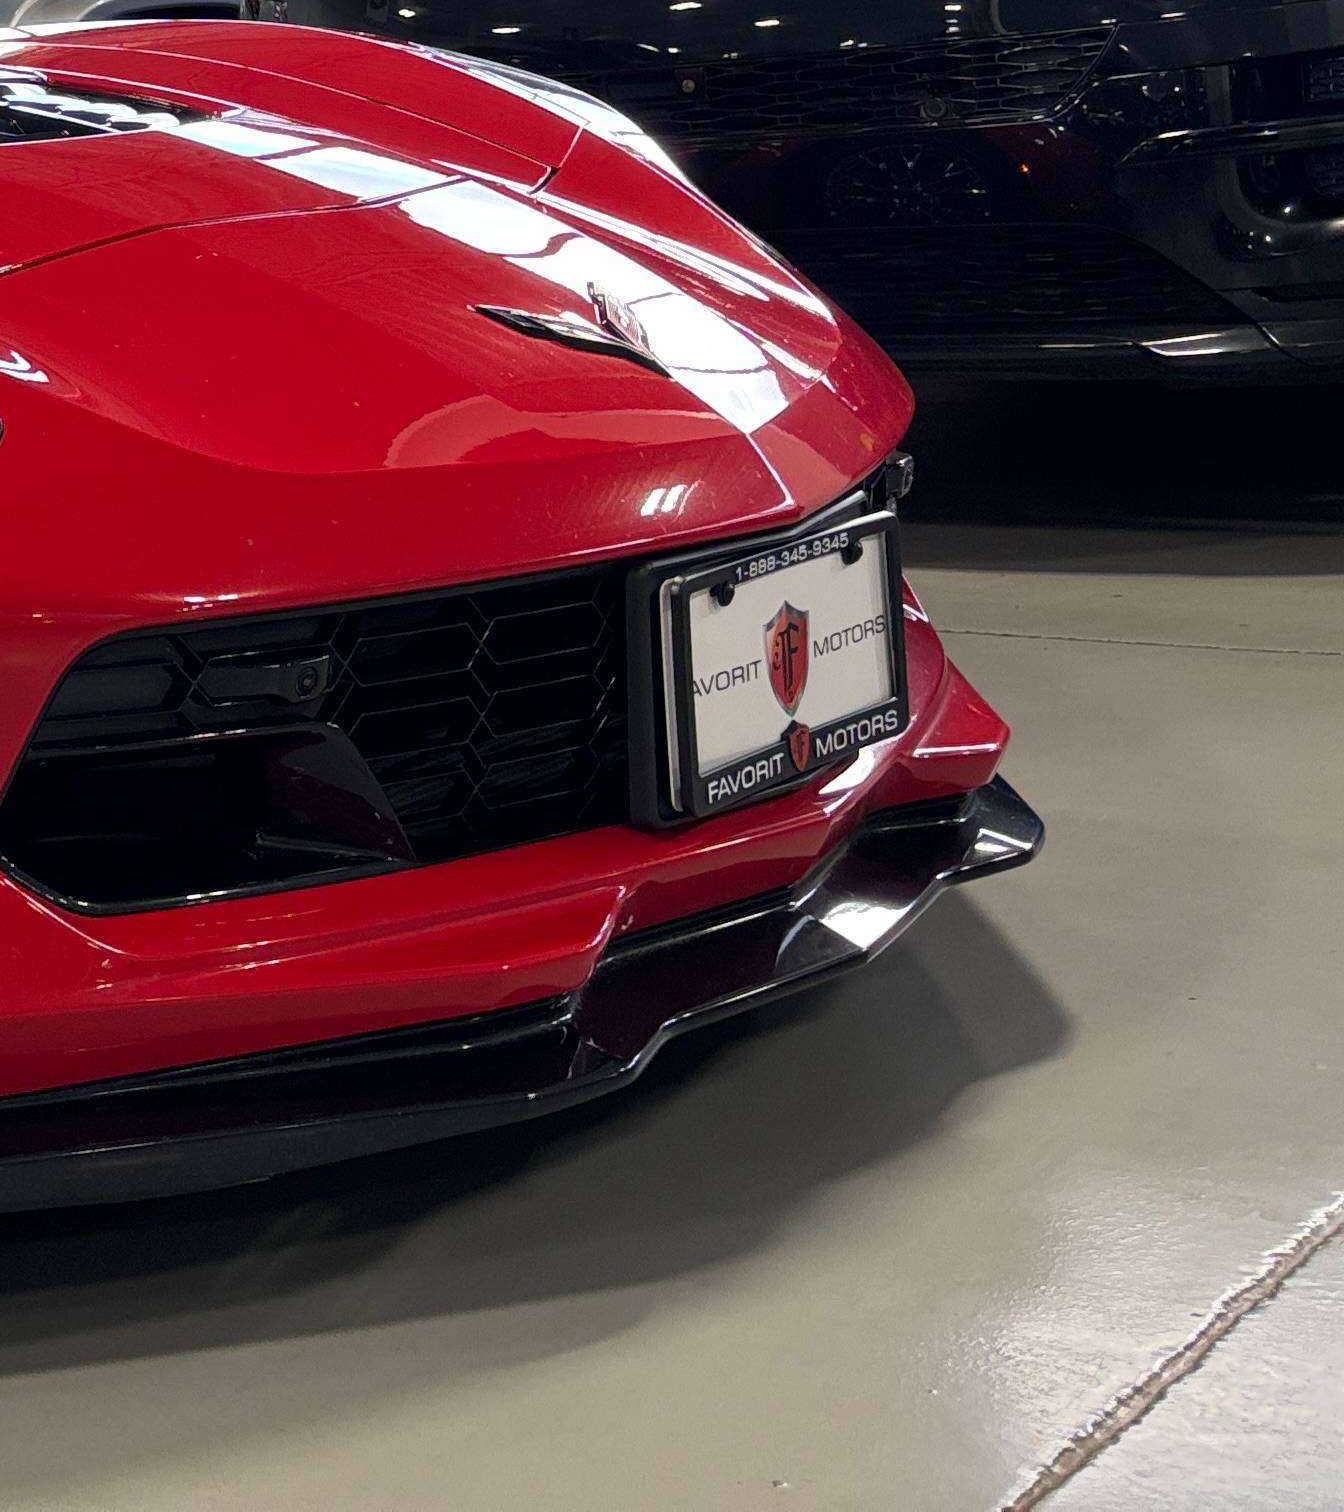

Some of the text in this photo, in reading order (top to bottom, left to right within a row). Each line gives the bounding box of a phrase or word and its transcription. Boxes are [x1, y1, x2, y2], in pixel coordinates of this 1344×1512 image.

[735, 532, 850, 583] 1-888-345-9345
[692, 659, 763, 698] AVORIT
[812, 614, 887, 659] MOTORS
[707, 752, 785, 805] FAVORIT
[815, 709, 900, 759] MOTORS
